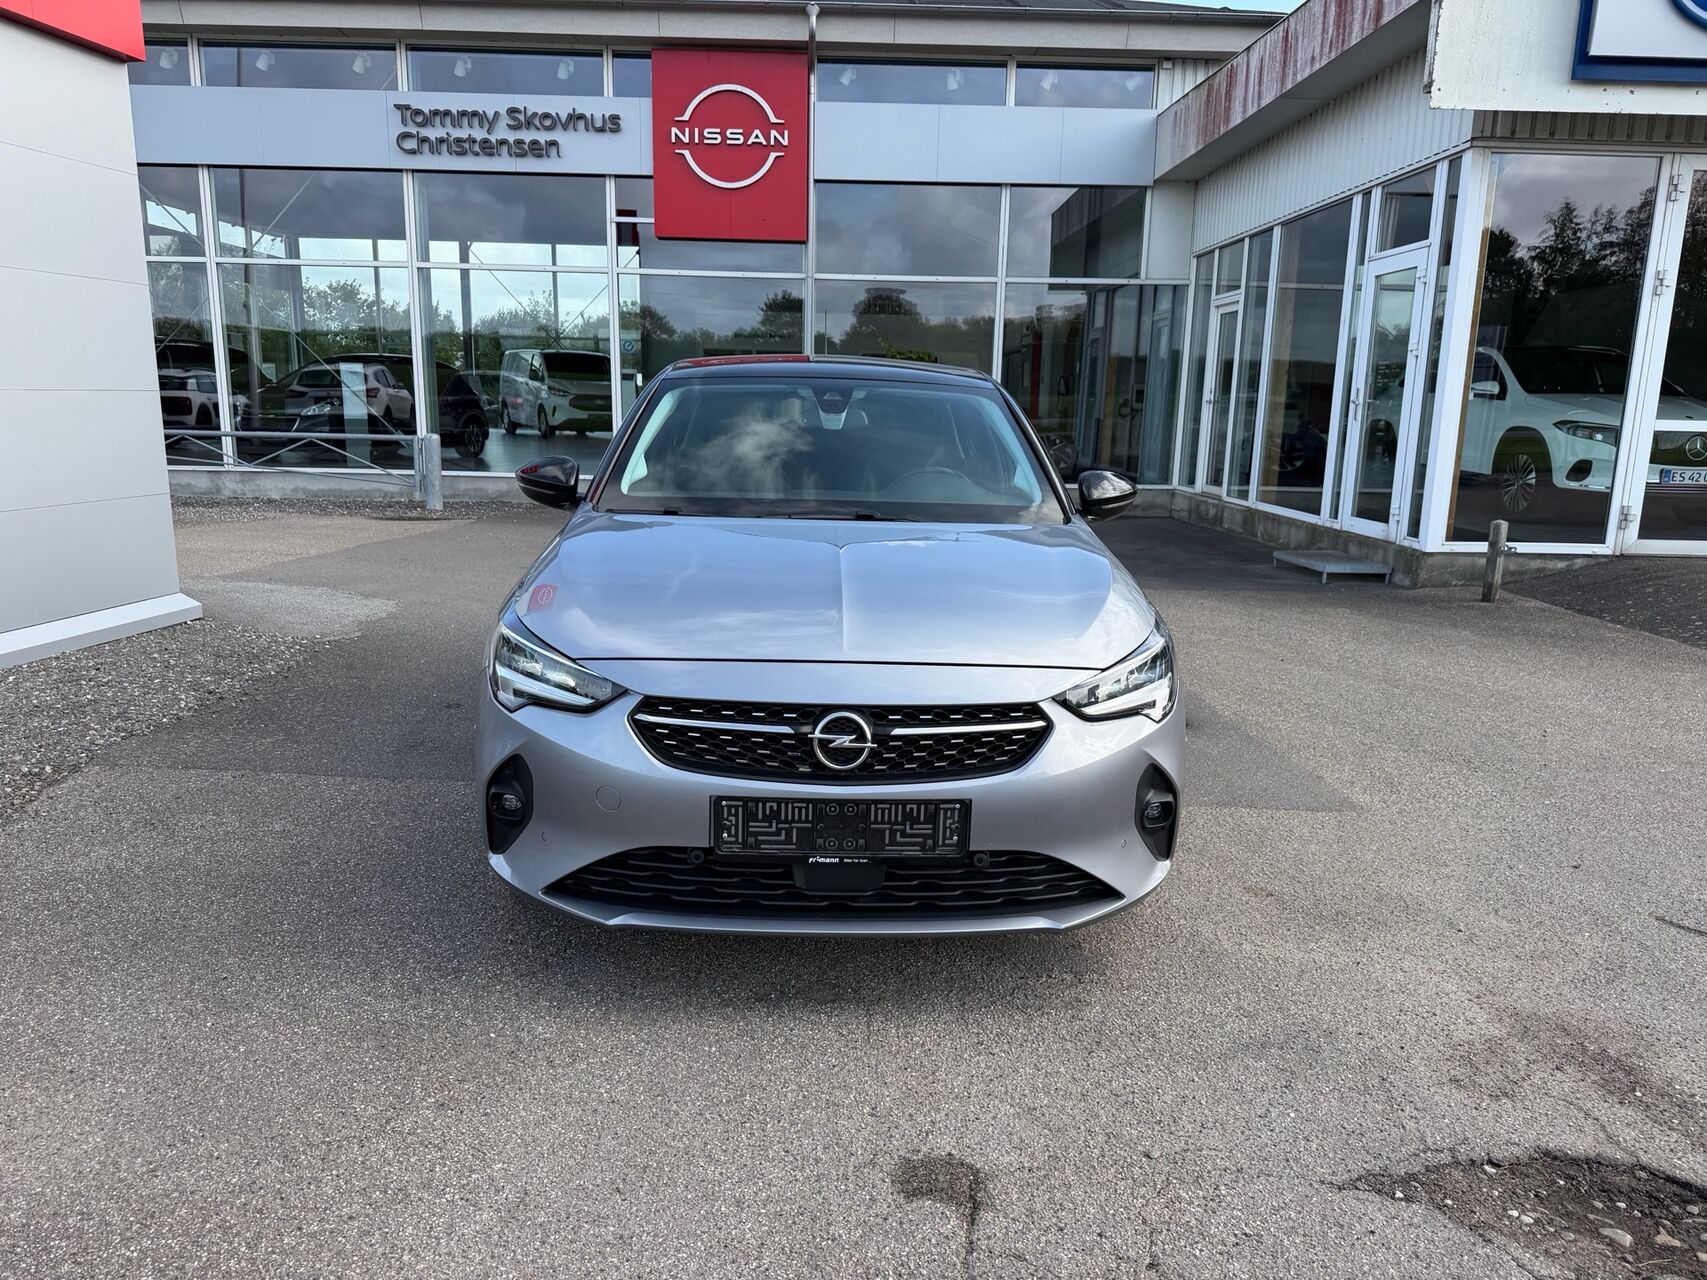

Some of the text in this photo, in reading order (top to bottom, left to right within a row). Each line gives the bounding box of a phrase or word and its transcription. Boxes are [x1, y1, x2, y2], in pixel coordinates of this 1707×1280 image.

[393, 103, 622, 134] Tommy Skovhus
[396, 130, 562, 159] Christensen
[671, 127, 789, 146] NISSAN
[1671, 471, 1686, 482] ES
[1688, 471, 1702, 483] 42
